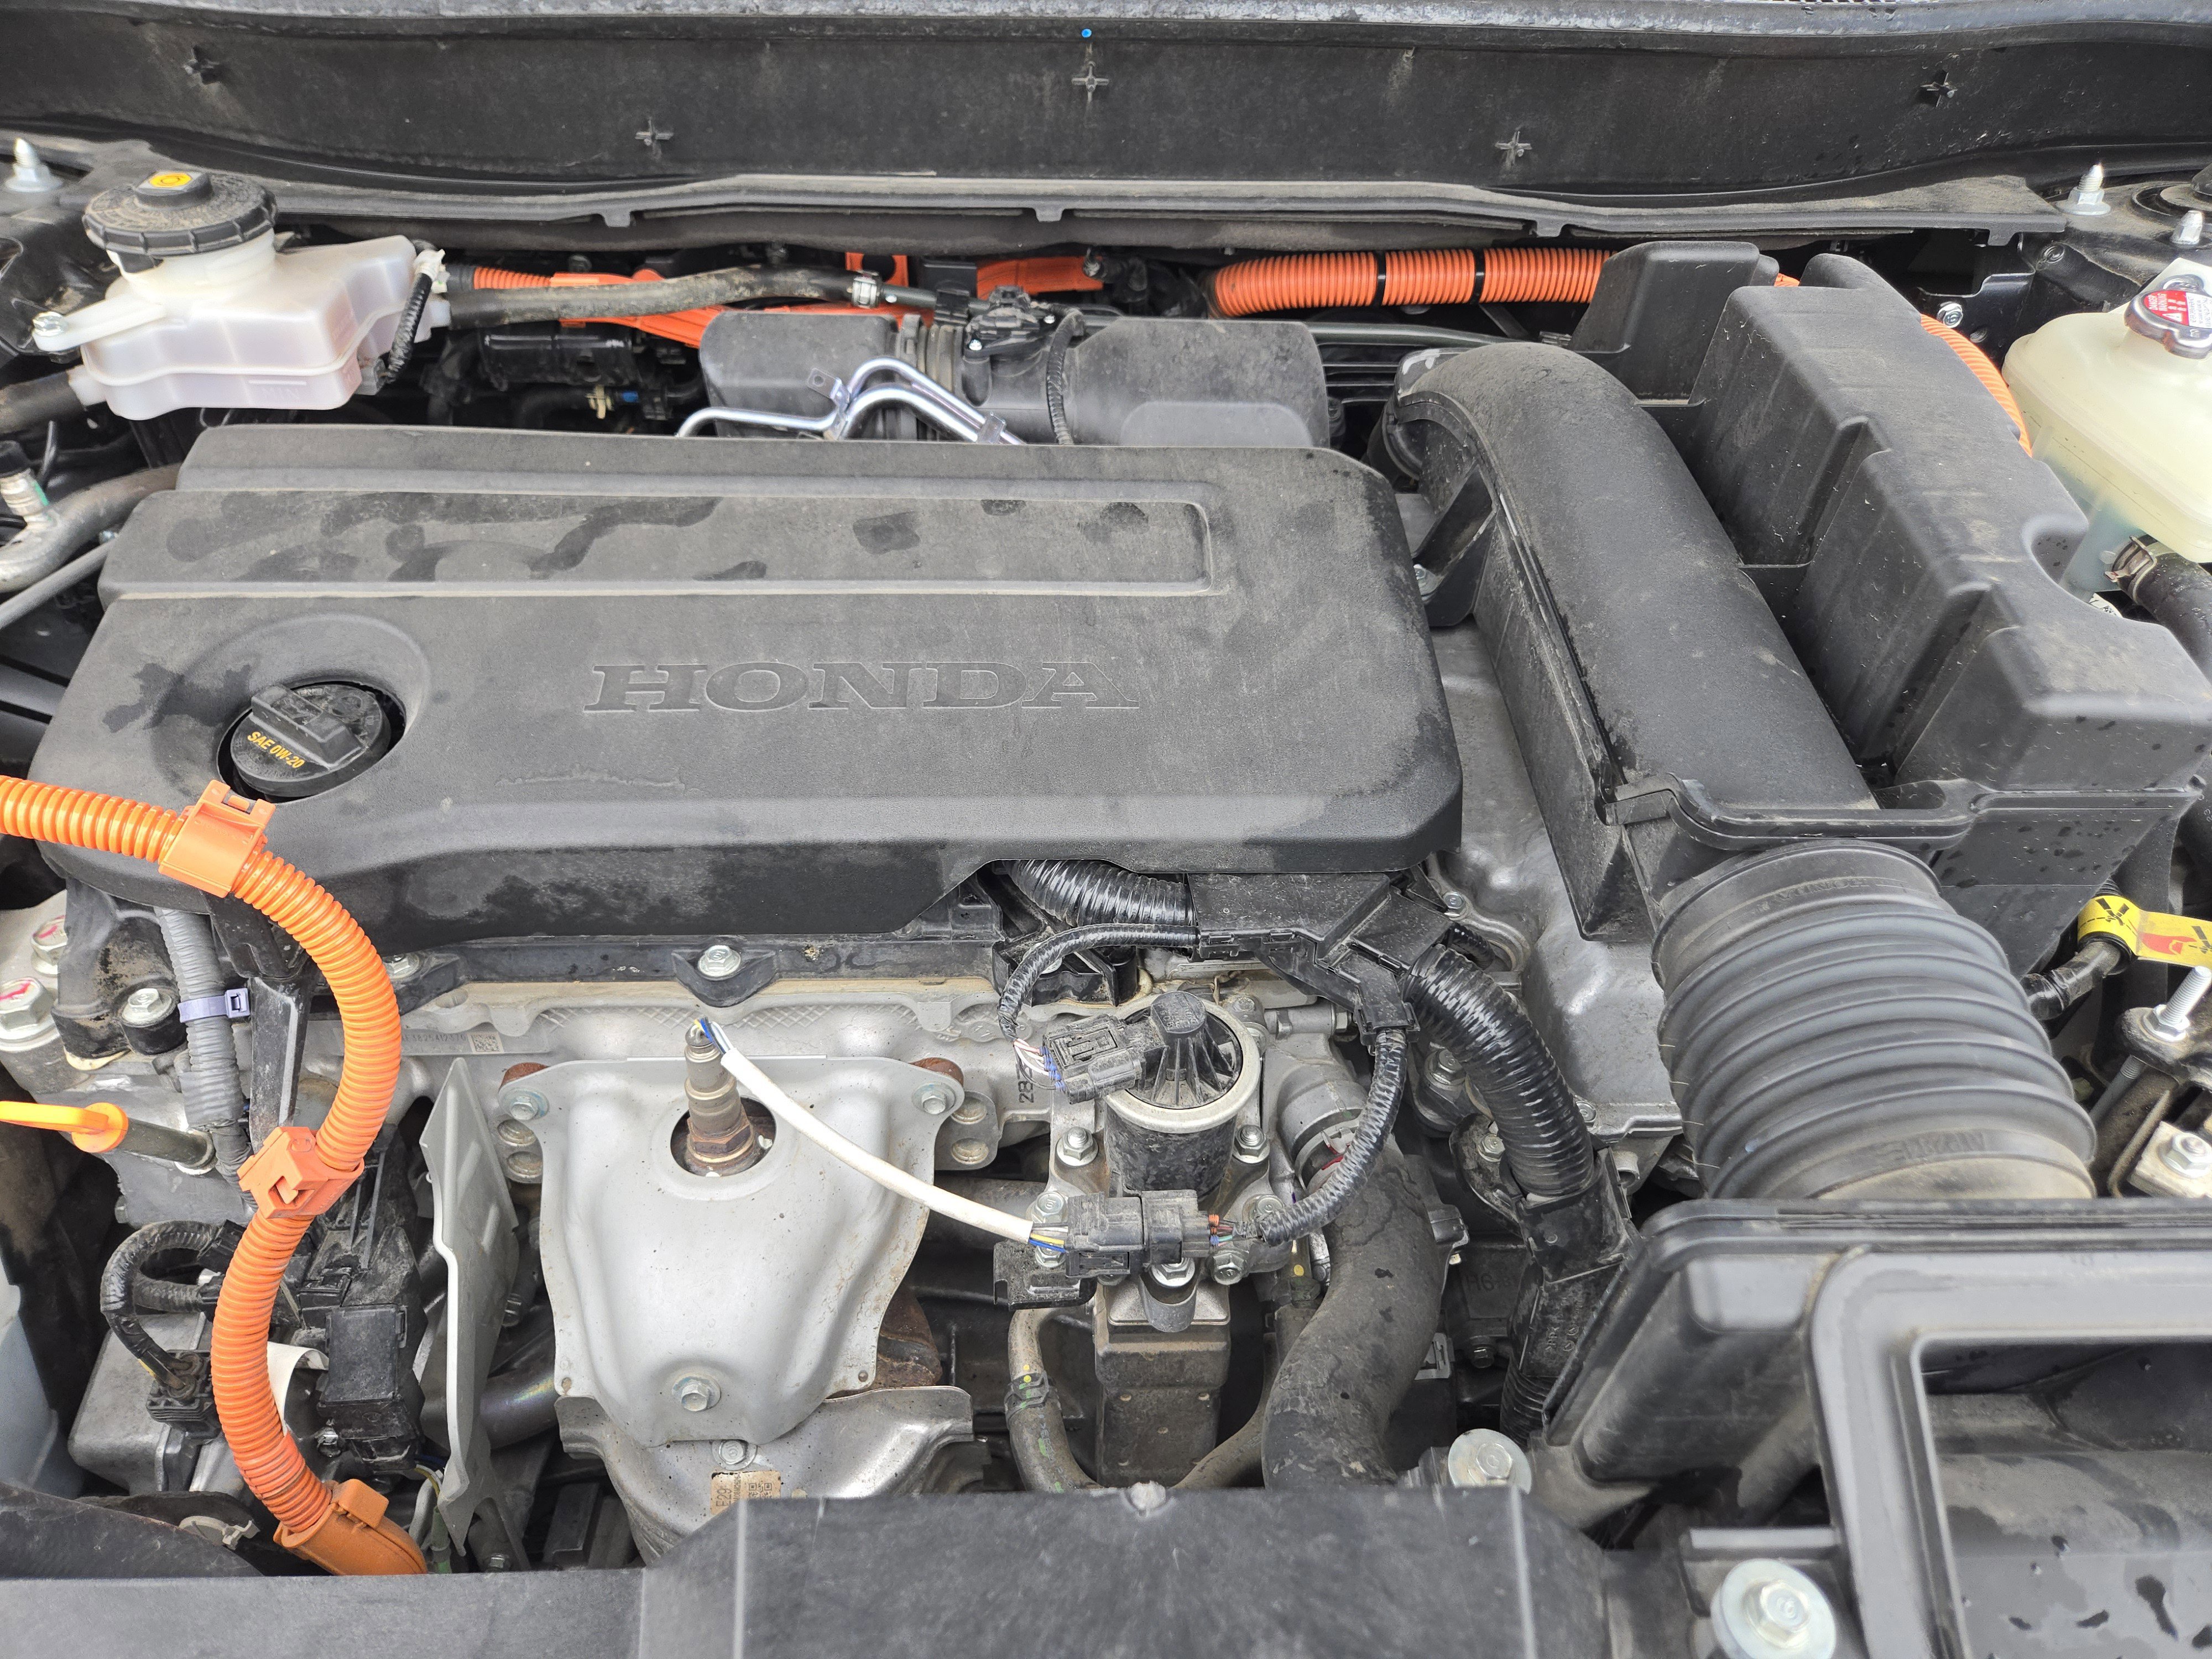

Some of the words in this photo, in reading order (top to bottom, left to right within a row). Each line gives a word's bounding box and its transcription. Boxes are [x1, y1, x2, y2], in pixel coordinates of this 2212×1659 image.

[2147, 294, 2158, 310] DANGER
[2157, 293, 2167, 311] WARNING
[583, 660, 1141, 713] HONDA
[247, 731, 276, 750] SAE
[269, 744, 305, 769] 0W-20
[716, 1488, 732, 1507] E29
